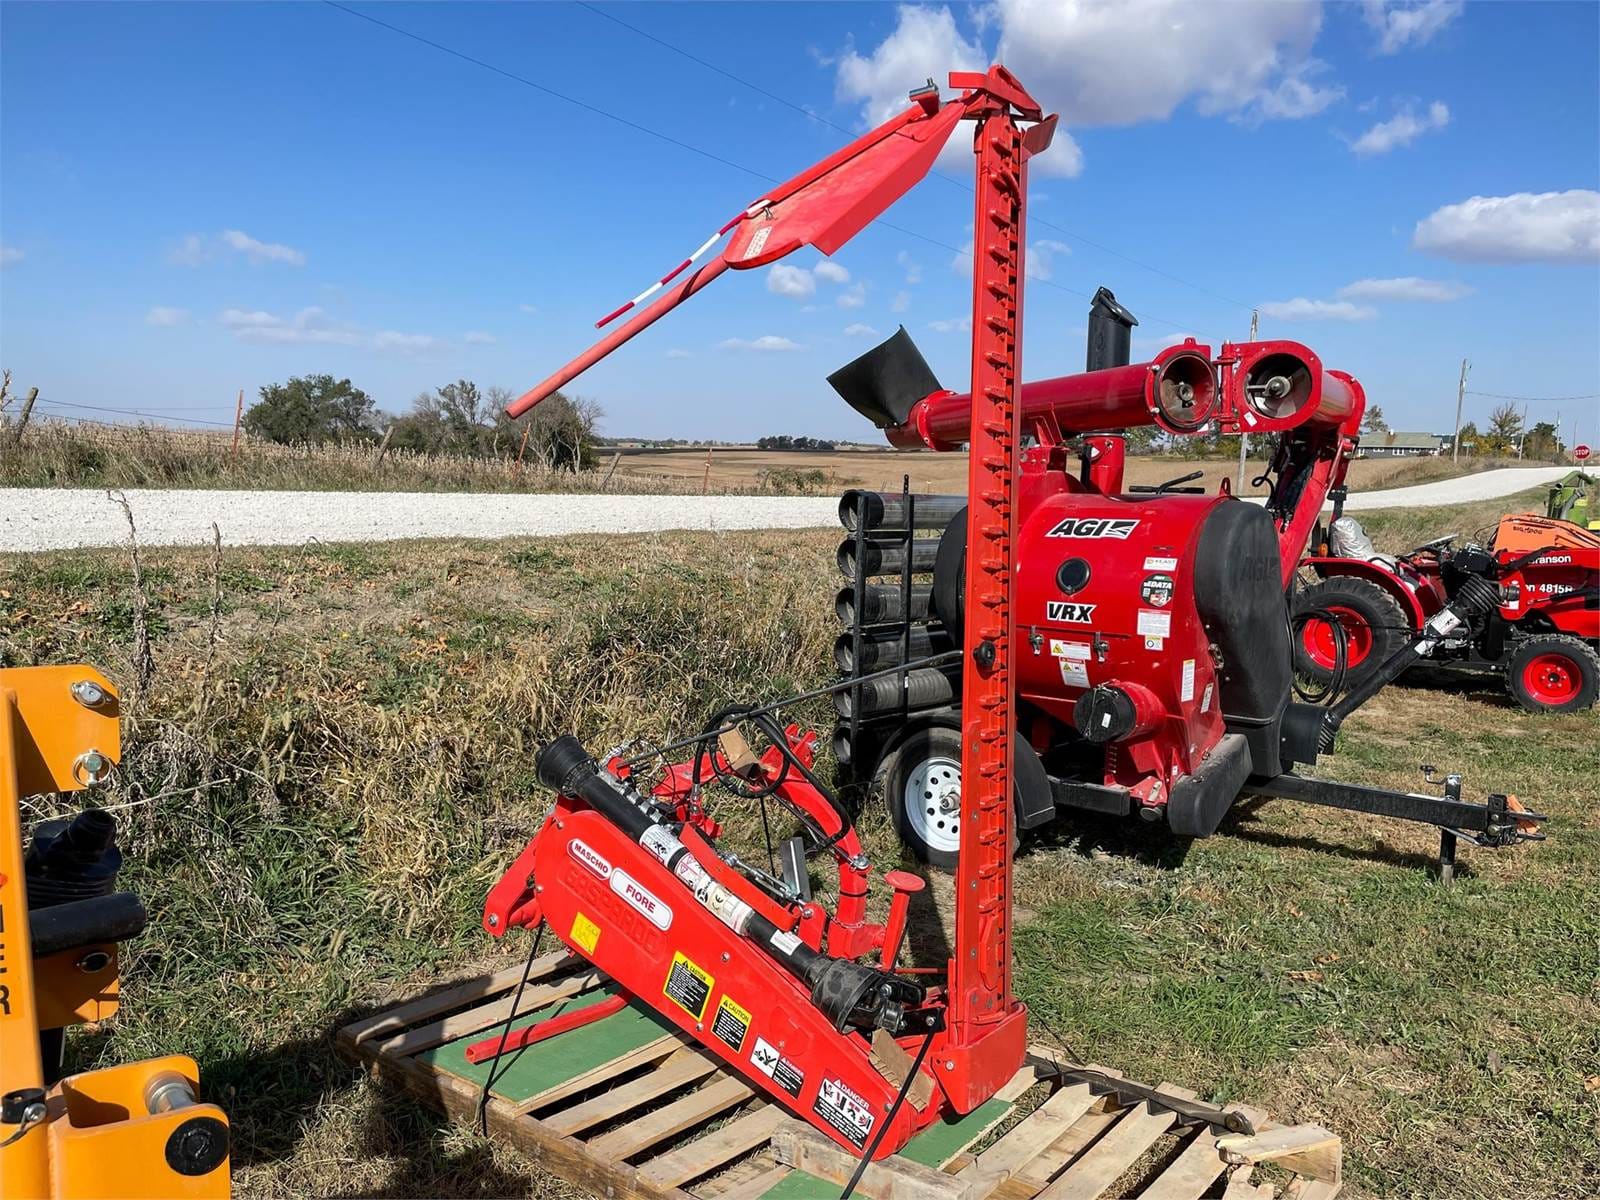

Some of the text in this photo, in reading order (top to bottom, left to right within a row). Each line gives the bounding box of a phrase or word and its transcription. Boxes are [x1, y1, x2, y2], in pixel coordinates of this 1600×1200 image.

[1574, 448, 1589, 456] STOP
[1050, 519, 1110, 537] AGI
[1528, 555, 1572, 564] ranson
[1048, 603, 1094, 623] VRX
[573, 843, 609, 874] MASCHIO
[625, 884, 656, 914] FIORE
[728, 1002, 750, 1023] CAUTION
[840, 1083, 870, 1111] DANGER
